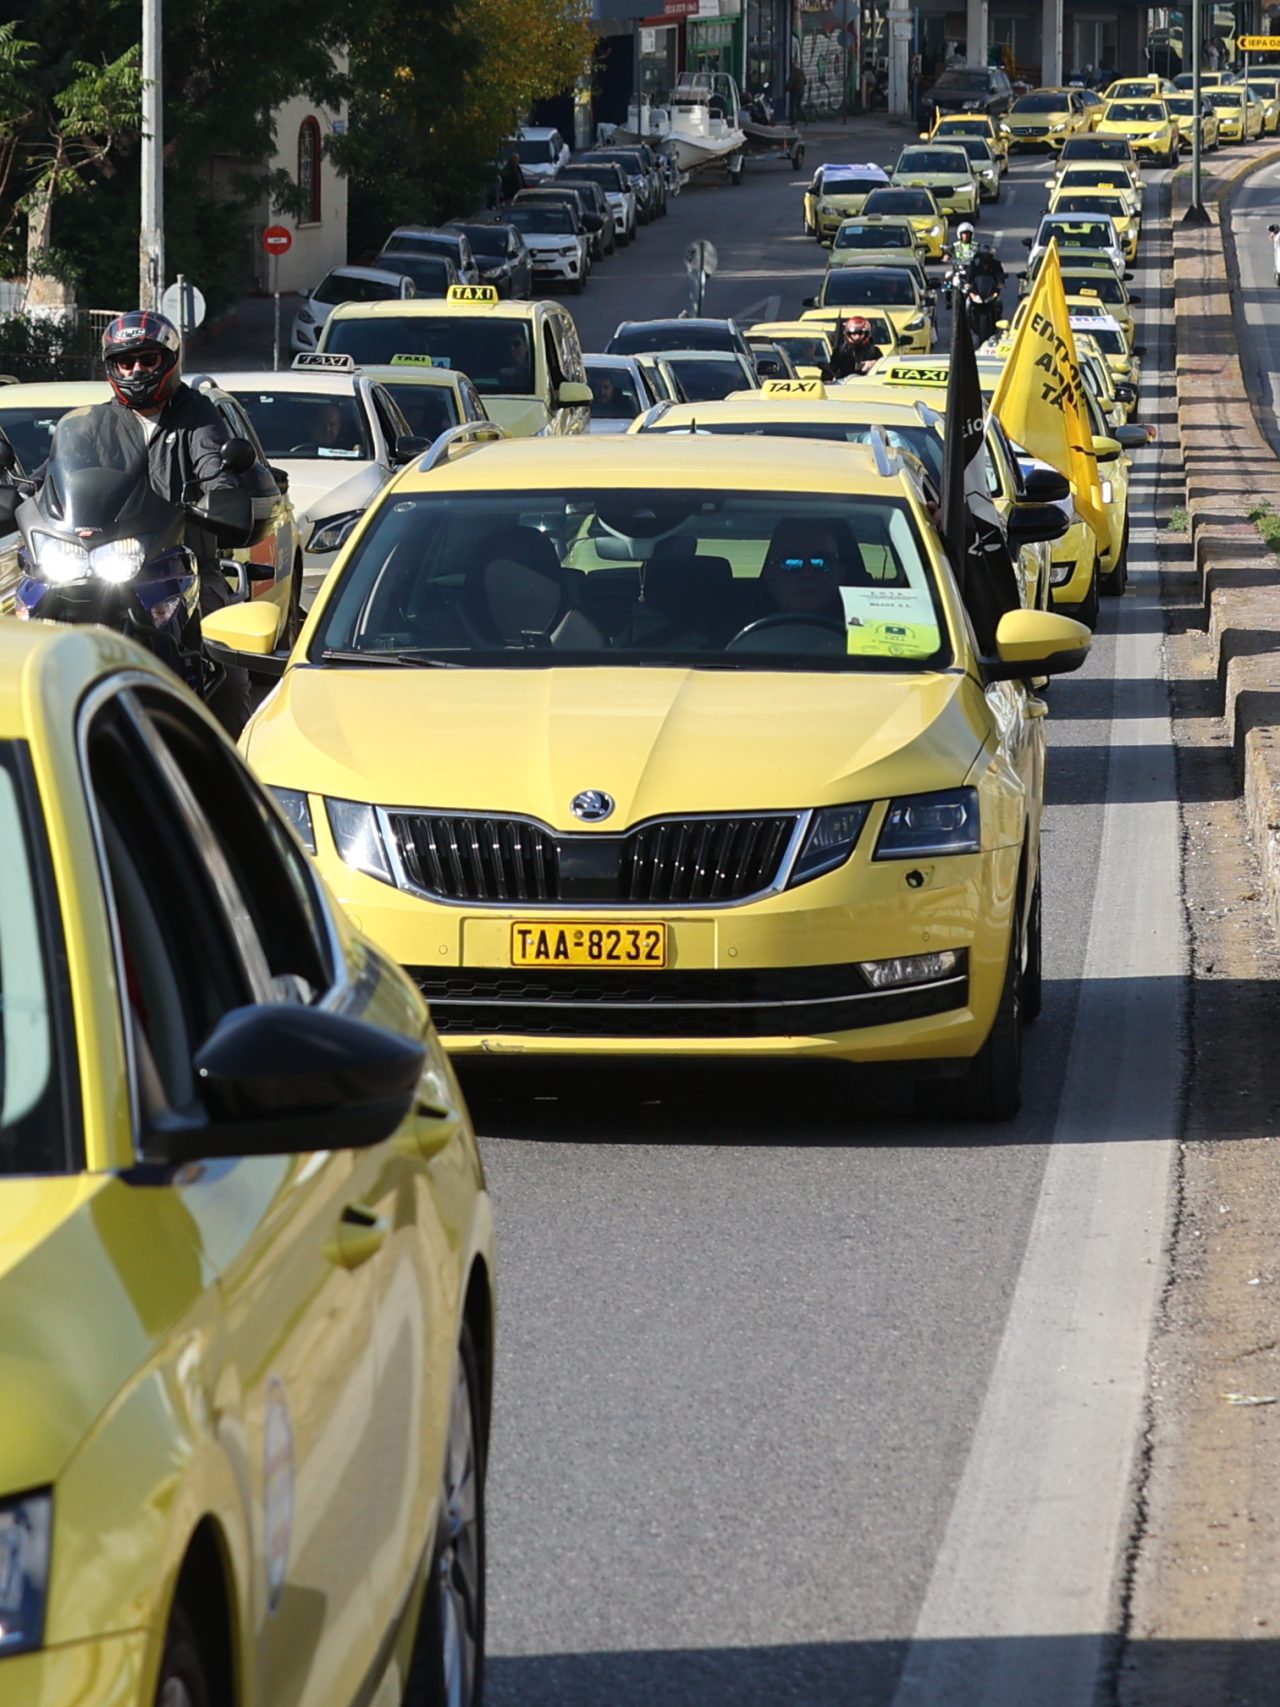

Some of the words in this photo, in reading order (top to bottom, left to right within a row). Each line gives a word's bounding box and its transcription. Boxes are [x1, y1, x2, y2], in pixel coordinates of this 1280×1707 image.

[454, 287, 491, 300] TAXI
[301, 357, 347, 366] TAXI
[894, 369, 948, 381] TAXI
[768, 382, 818, 392] TAXI
[517, 929, 661, 960] TAA-8232
